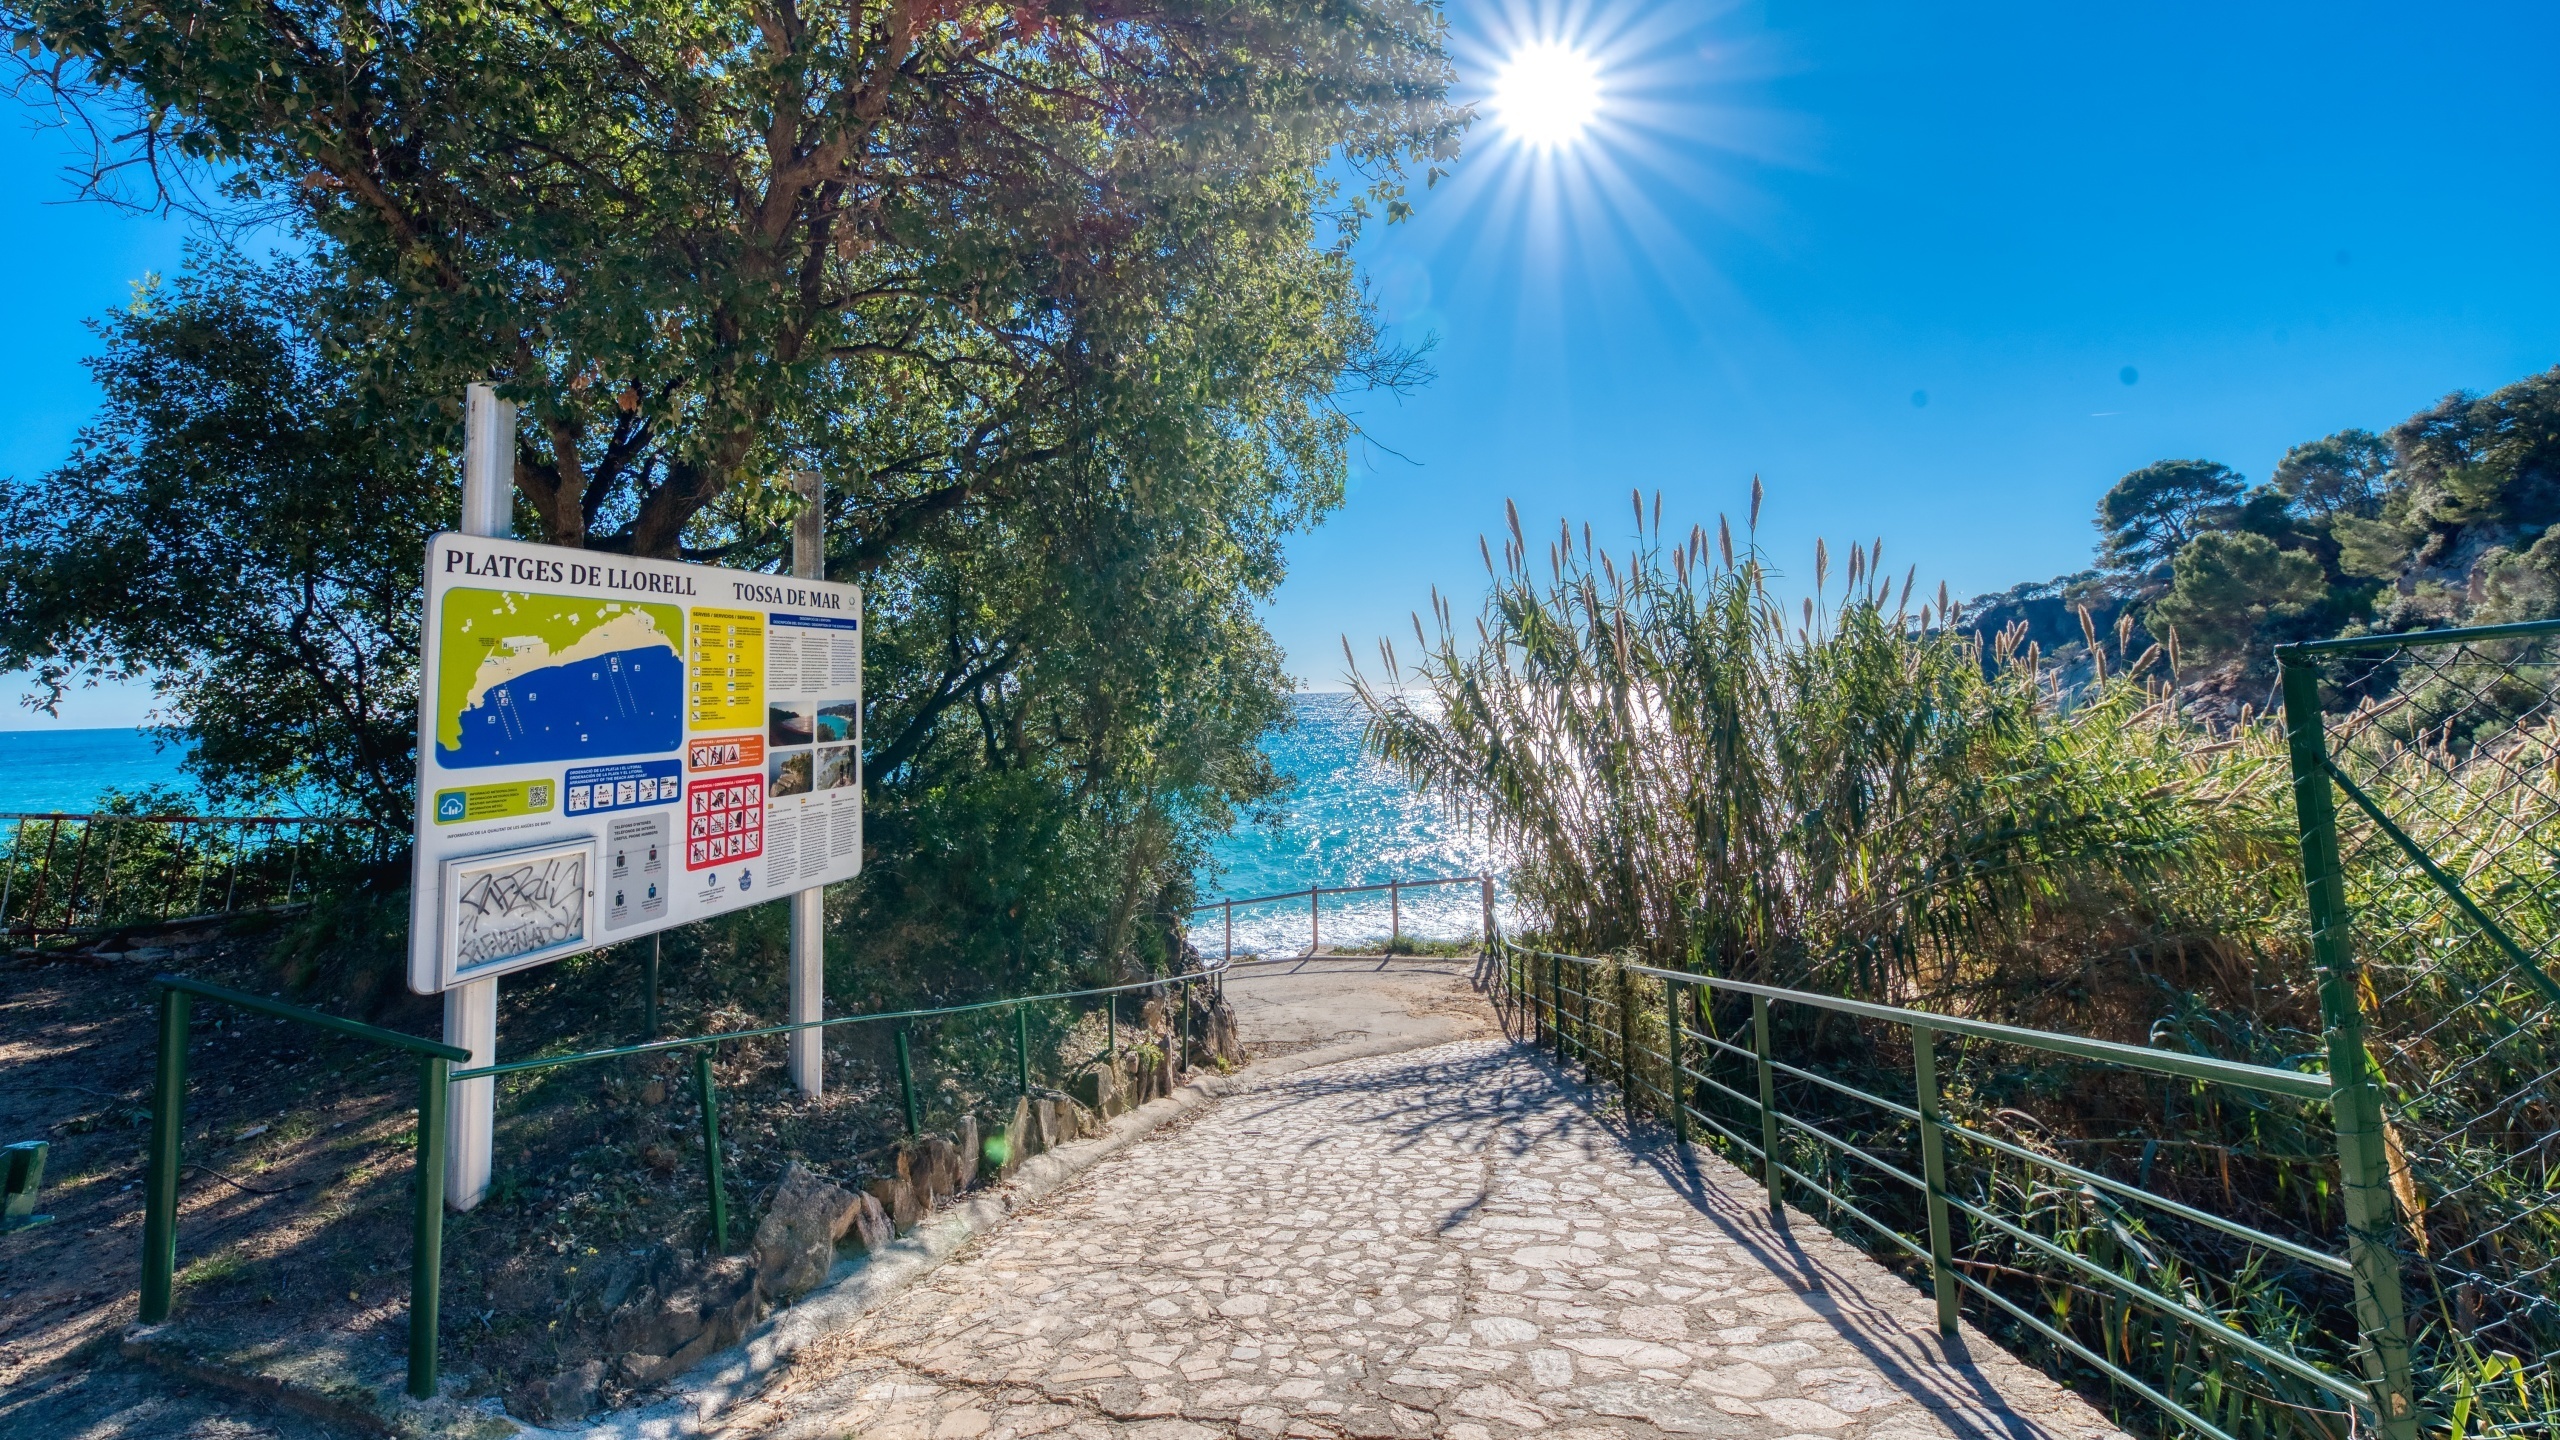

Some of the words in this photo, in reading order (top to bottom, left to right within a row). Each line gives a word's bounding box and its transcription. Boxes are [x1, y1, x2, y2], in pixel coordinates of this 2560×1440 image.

[446, 550, 563, 582] PLATGES
[570, 564, 601, 586] DE
[608, 568, 696, 596] LLORELL
[733, 582, 783, 604] TOSSA
[787, 588, 806, 606] DE
[810, 591, 840, 609] MAR
[447, 831, 474, 839] INFORMACIÓ
